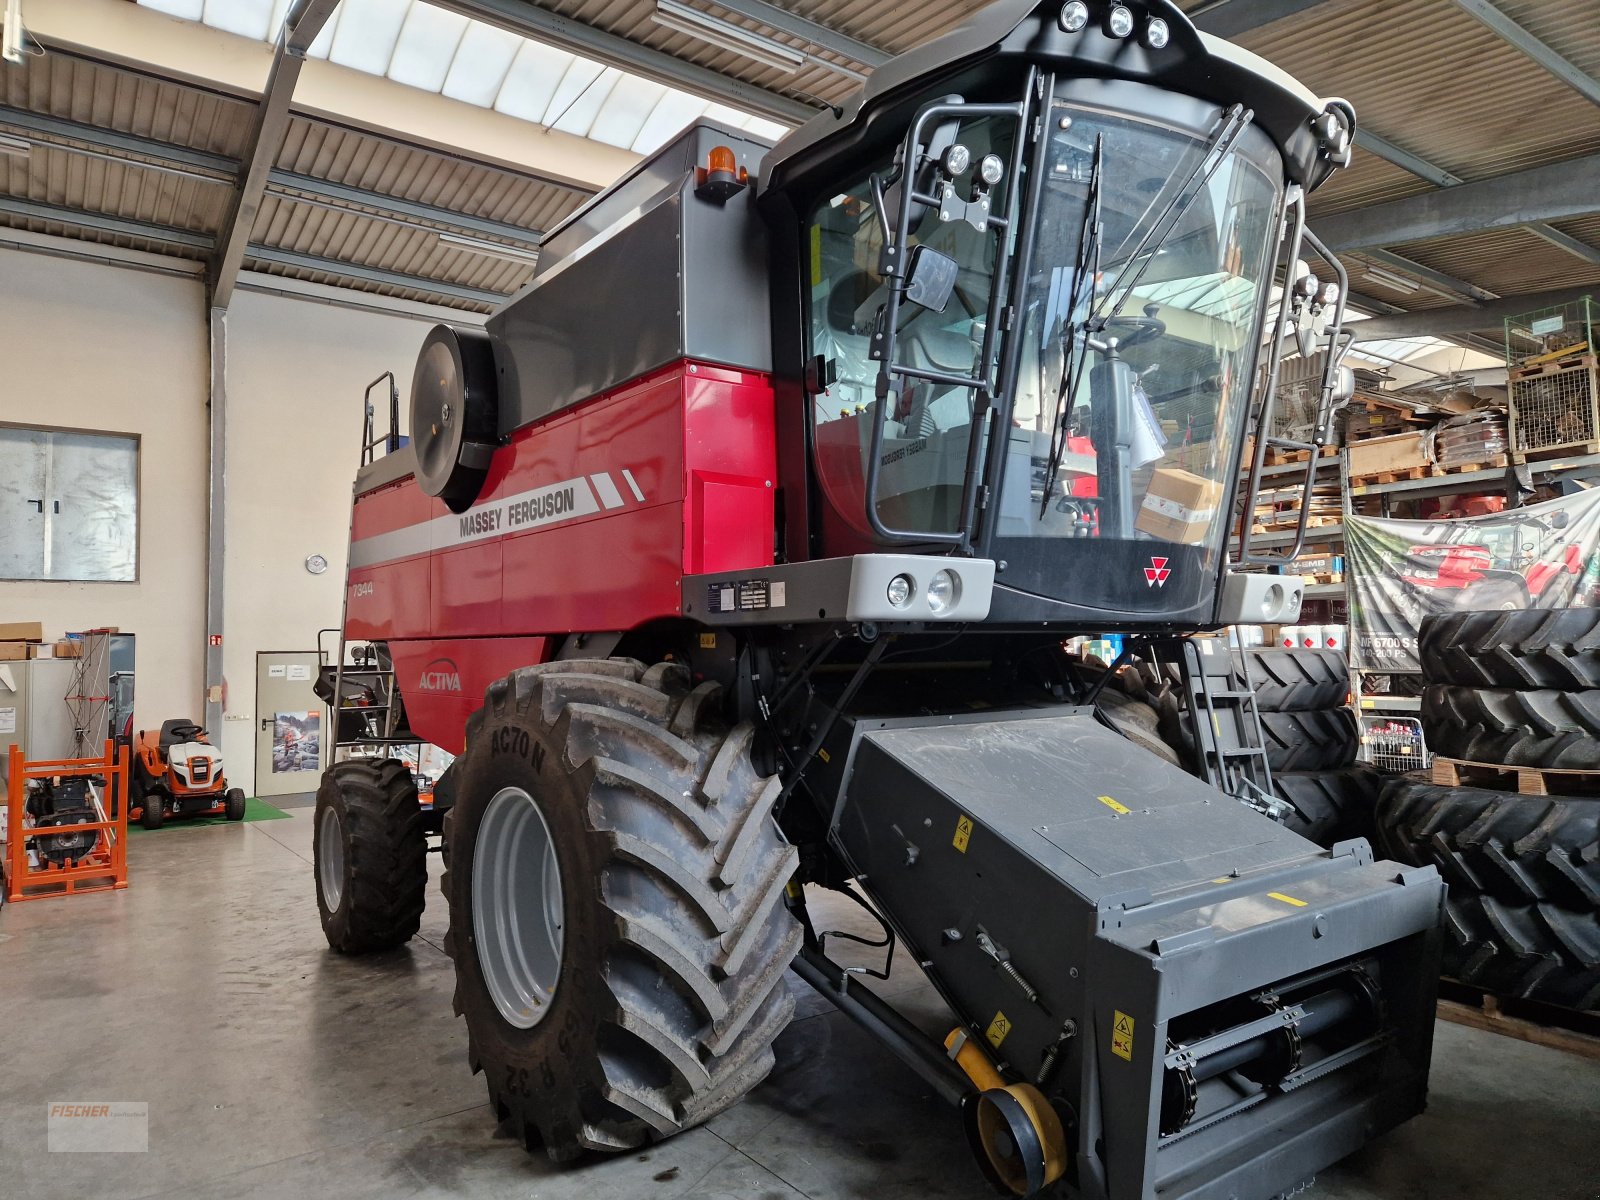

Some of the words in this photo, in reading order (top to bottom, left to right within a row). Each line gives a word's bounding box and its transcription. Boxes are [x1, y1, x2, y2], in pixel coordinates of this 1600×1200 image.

[460, 508, 502, 538] MASSEY
[509, 488, 574, 527] FERGUSON
[1374, 637, 1400, 648] 6700
[1394, 650, 1406, 658] PS
[419, 672, 461, 691] ACTIVA
[491, 726, 529, 759] AC70
